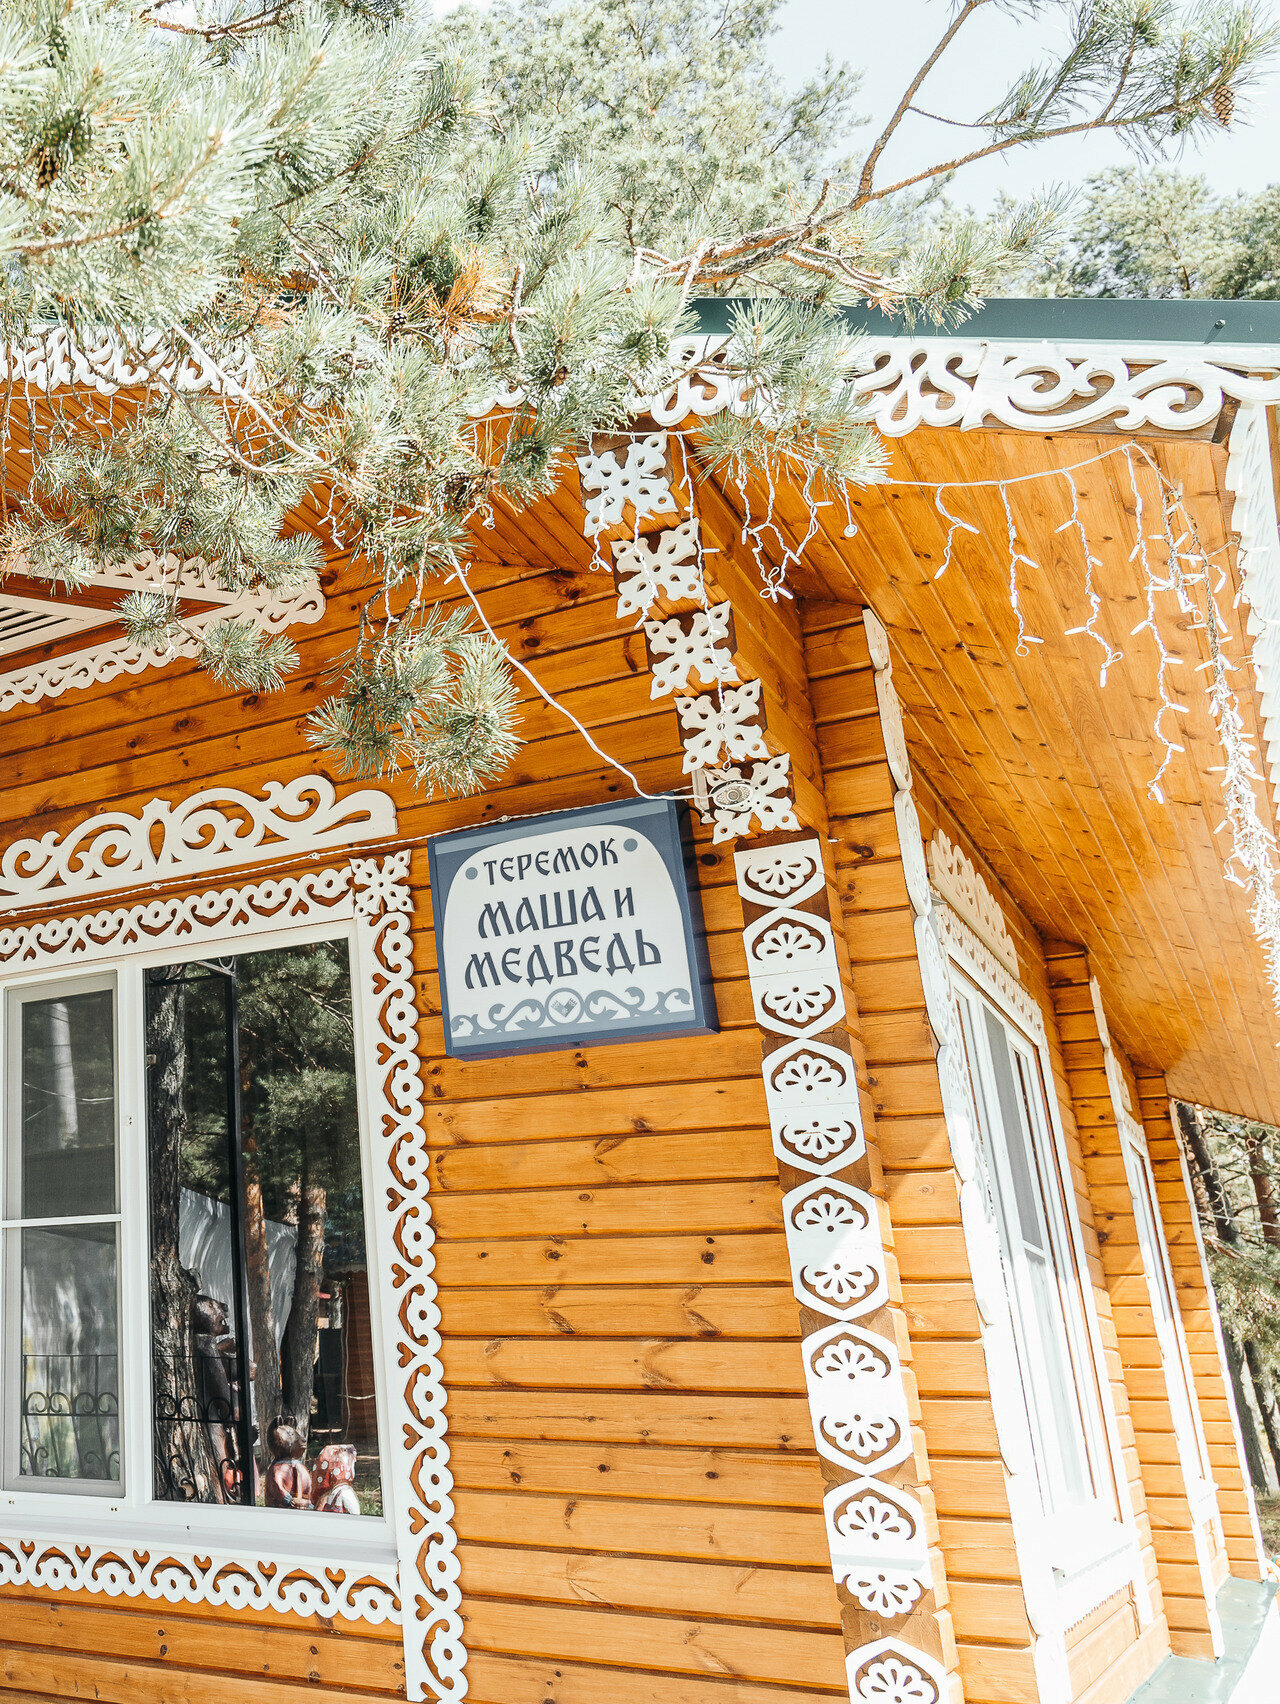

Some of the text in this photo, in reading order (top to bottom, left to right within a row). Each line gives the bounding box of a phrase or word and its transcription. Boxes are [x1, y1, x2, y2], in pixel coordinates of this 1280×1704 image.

[483, 838, 619, 885] ТЕРЕМОК
[477, 885, 606, 939] МАША
[464, 929, 662, 990] МЕДВЕДЬ
